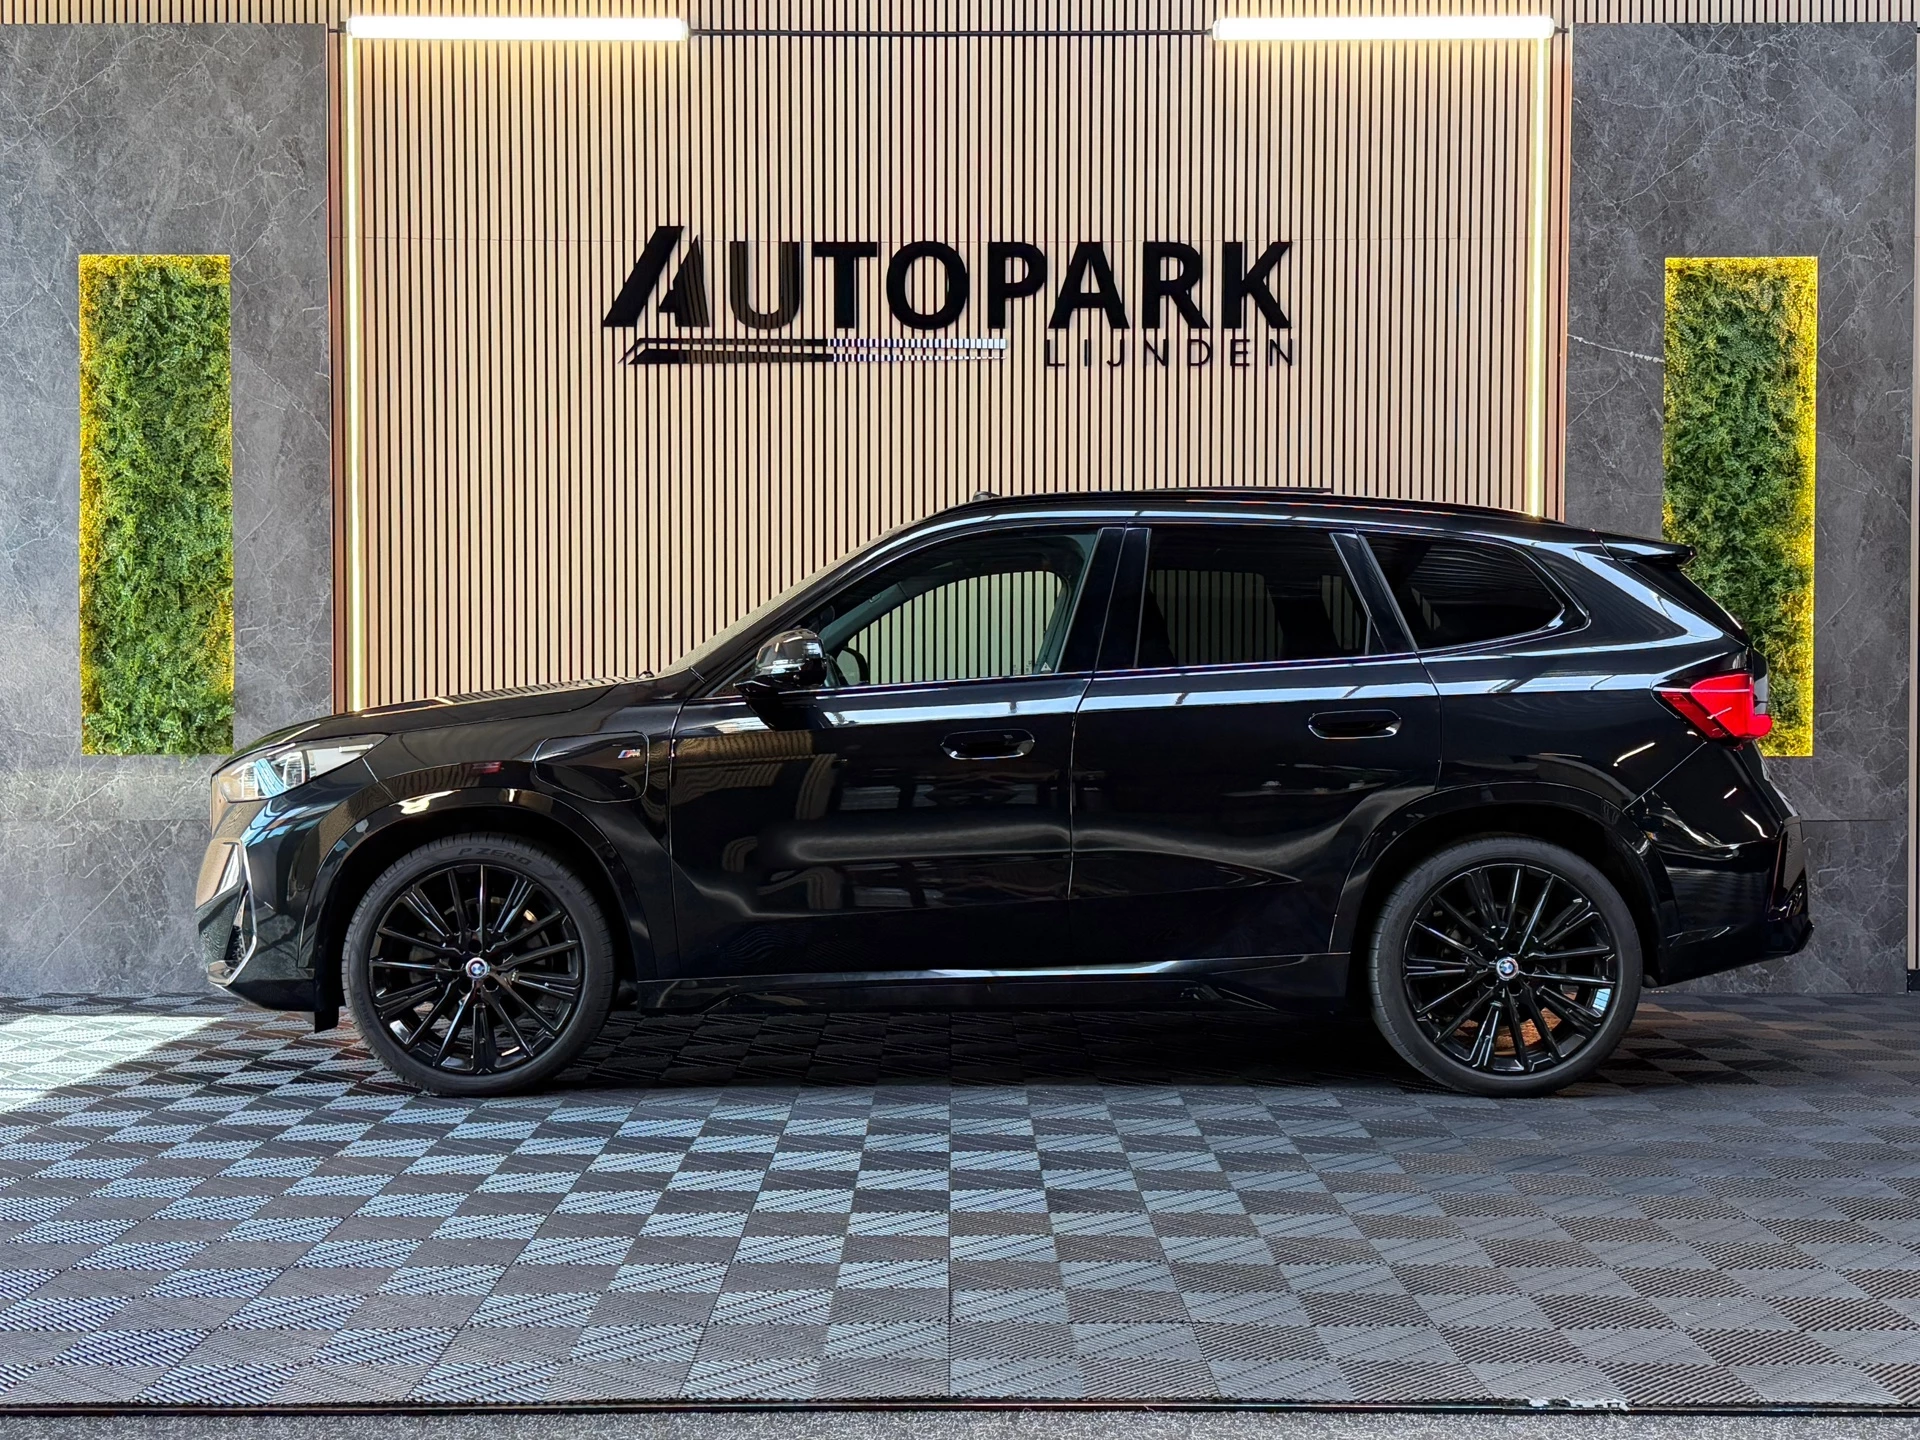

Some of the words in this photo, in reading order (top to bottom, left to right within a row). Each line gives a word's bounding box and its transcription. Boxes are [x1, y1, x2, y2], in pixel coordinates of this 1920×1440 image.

[603, 225, 1293, 331] AUTOPARK
[1046, 338, 1293, 367] LIJNDEN
[476, 847, 532, 866] ZERO
